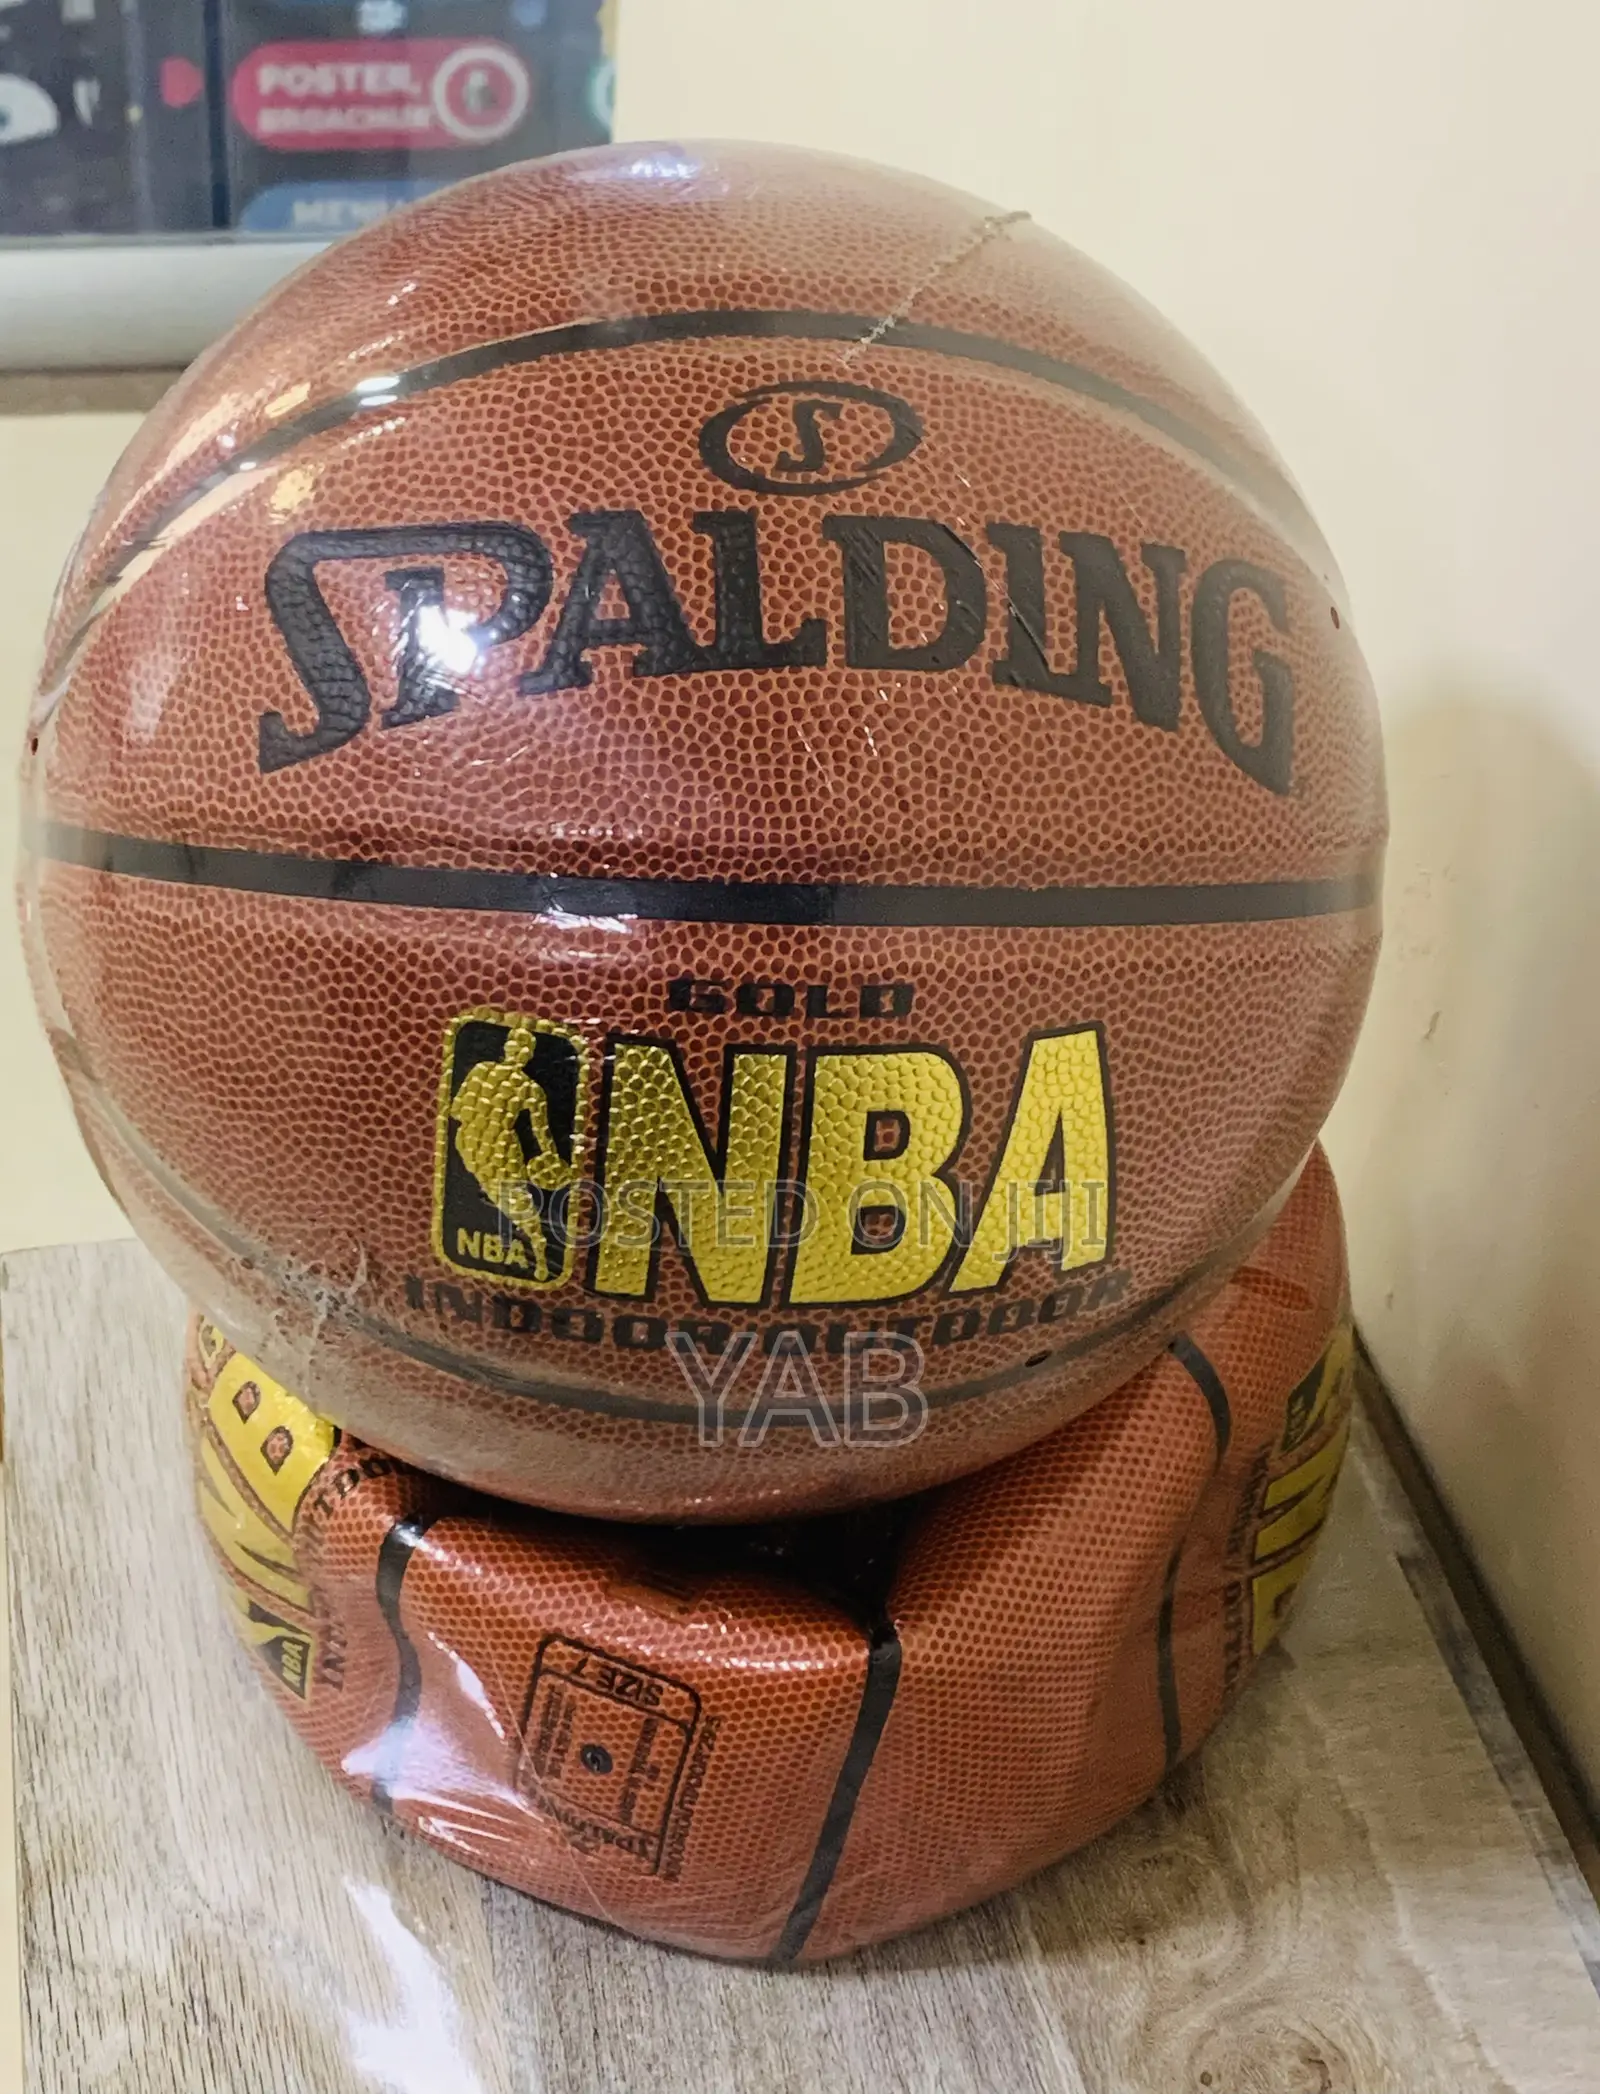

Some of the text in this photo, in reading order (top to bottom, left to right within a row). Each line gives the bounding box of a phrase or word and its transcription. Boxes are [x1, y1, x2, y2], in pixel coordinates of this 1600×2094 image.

[256, 508, 1296, 796] SPALDING
[668, 978, 916, 1019] GOLD
[594, 1019, 1114, 1306] NBA
[456, 1226, 530, 1270] NBA
[595, 1664, 664, 1707] SIZE
